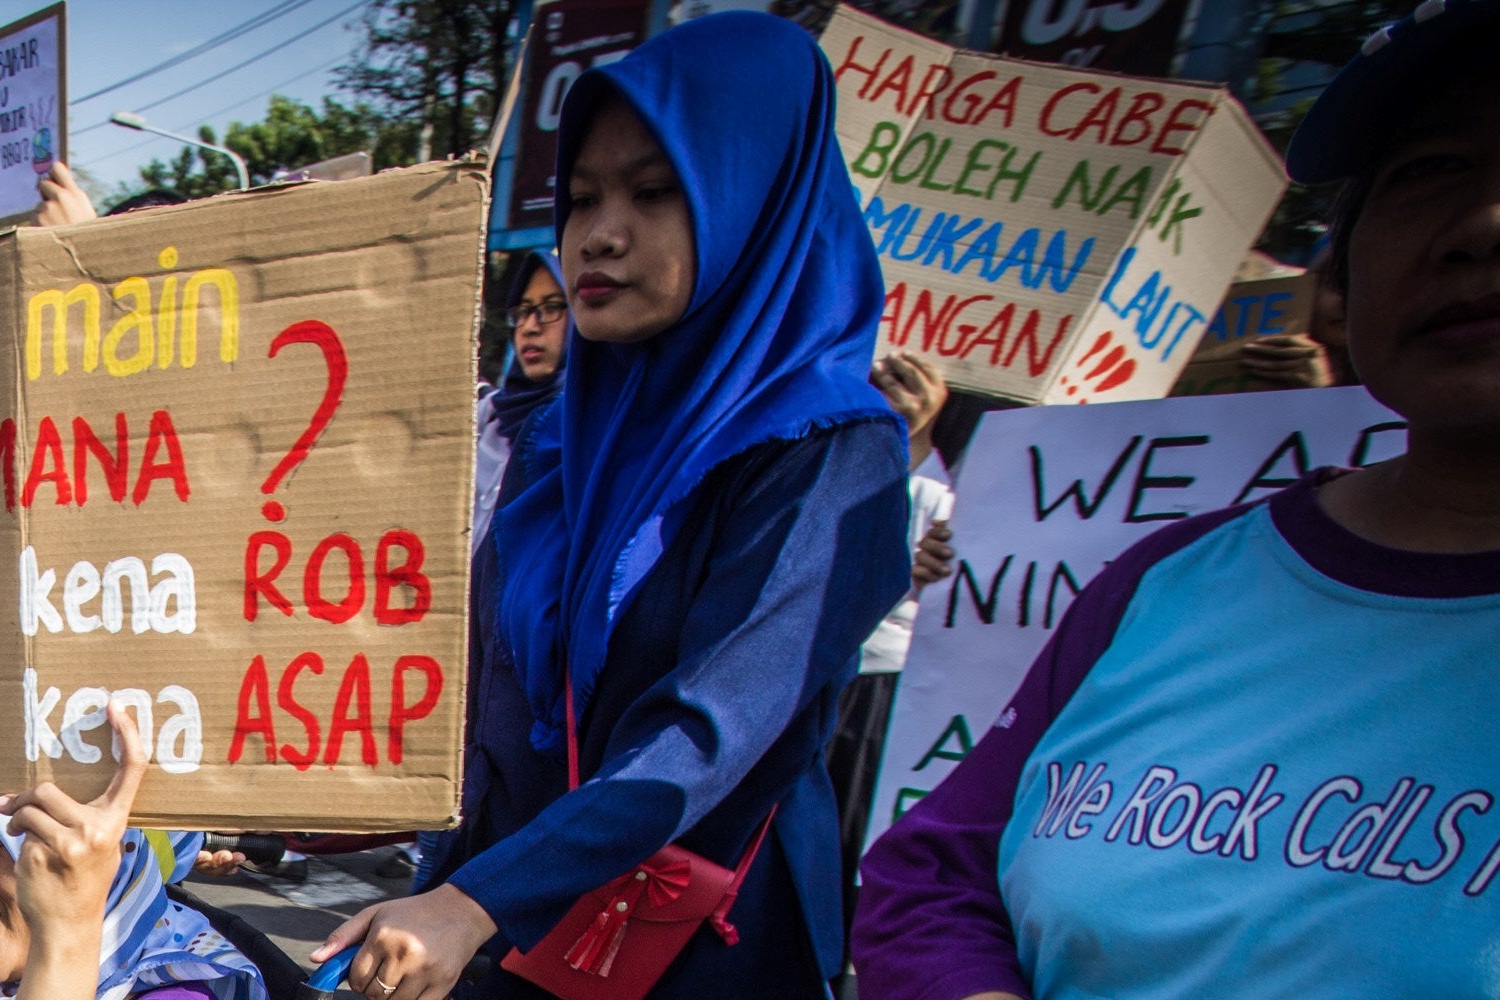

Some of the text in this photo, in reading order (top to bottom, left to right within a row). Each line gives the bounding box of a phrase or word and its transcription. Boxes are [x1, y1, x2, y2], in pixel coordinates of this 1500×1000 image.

[834, 36, 1217, 156] HARGA CABE
[852, 121, 1203, 256] BOLEH NAIK
[24, 245, 240, 381] main
[850, 185, 1207, 363] MUKAAN LAUT
[260, 319, 350, 522] ?
[1028, 433, 1212, 524] WE
[19, 544, 197, 637] kena
[243, 528, 432, 626] ROB
[943, 553, 1115, 629] NIN
[22, 667, 204, 774] kena
[226, 650, 444, 772] ASAP
[1032, 761, 1114, 840] We
[1103, 763, 1285, 862] Rock
[1284, 774, 1494, 885] CdLS
